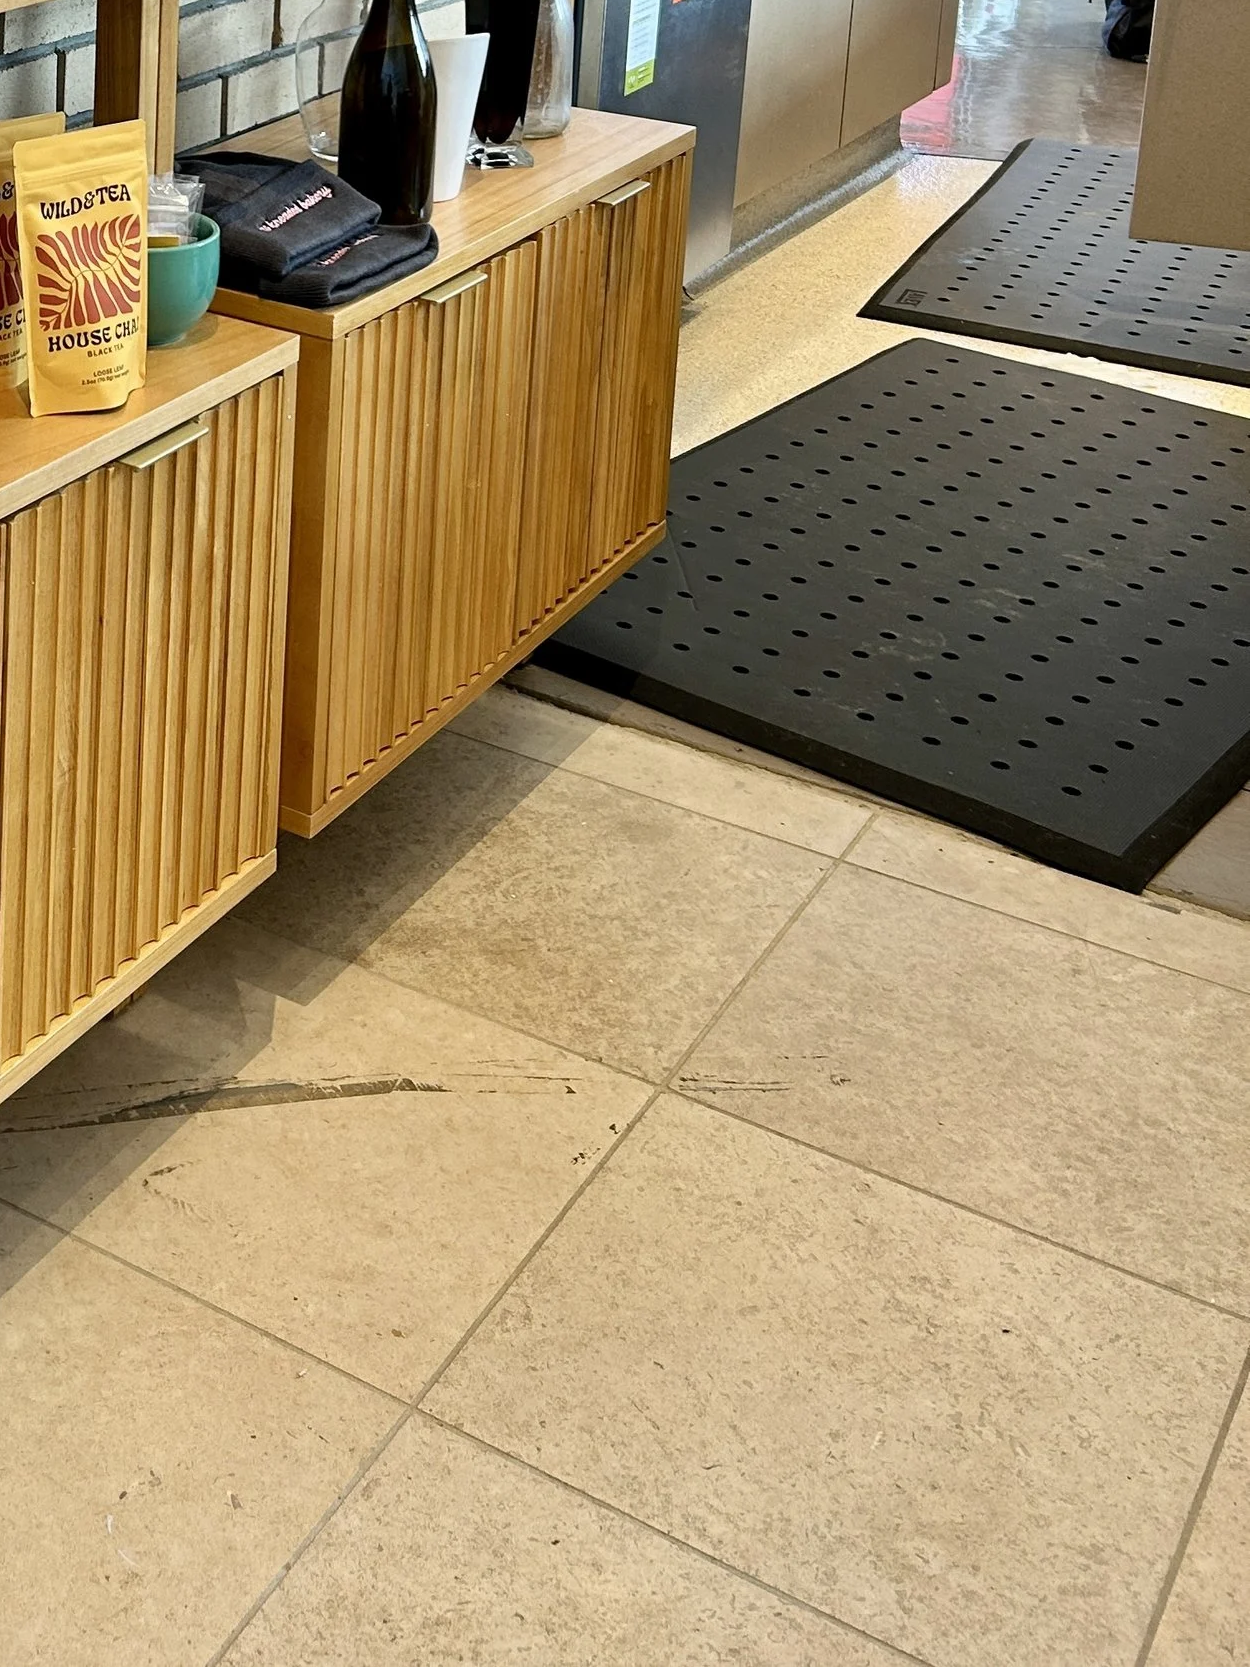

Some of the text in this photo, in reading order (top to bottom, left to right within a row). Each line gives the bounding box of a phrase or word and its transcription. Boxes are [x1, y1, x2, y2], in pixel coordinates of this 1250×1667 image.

[40, 184, 131, 220] WILD&TEA
[12, 328, 23, 338] TEA
[48, 316, 140, 353] HOUSE CHAI
[87, 344, 124, 358] BLACK TEA
